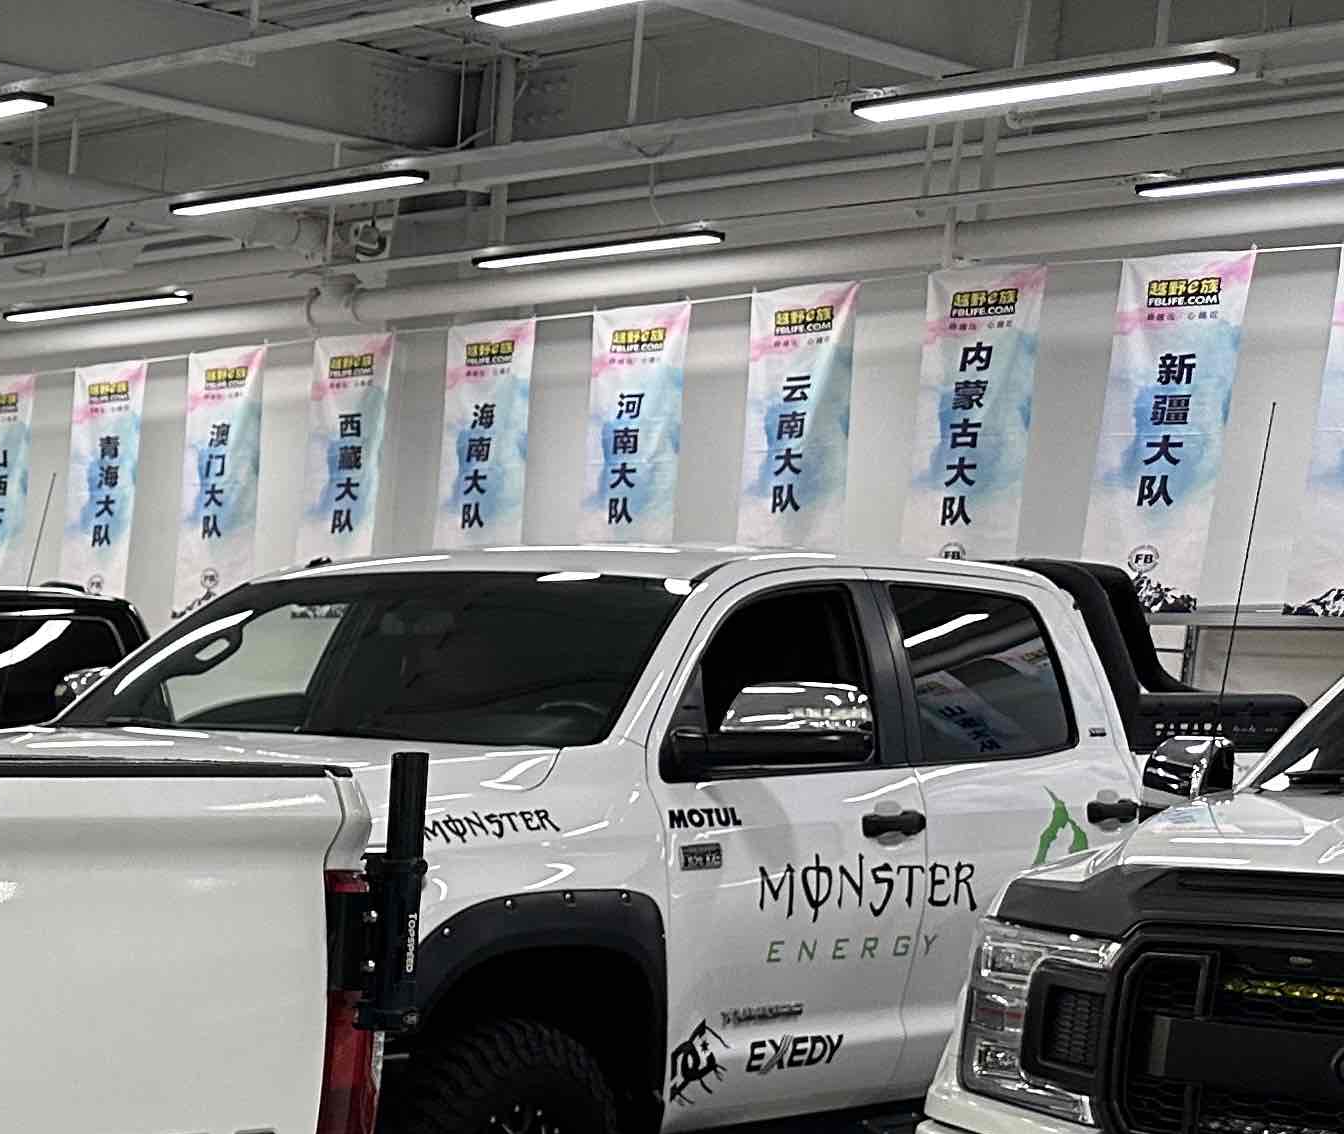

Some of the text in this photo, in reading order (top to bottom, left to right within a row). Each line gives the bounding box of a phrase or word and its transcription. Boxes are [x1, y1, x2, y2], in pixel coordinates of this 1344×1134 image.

[201, 423, 230, 539] 澳门大队
[330, 412, 363, 534] 西藏大队
[459, 403, 497, 529] 海南大队
[608, 392, 645, 525] 河南大队
[771, 374, 812, 514] 云南大队
[940, 341, 994, 526] 内蒙古大队
[1136, 352, 1197, 507] 新疆大队
[91, 435, 120, 547] 青海大队
[1134, 554, 1153, 564] FB
[423, 808, 561, 844] MONSTER
[668, 807, 743, 829] MOTUL
[758, 853, 978, 924] MONSTER
[766, 934, 938, 963] ENERGY
[745, 1034, 844, 1075] EXEDY
